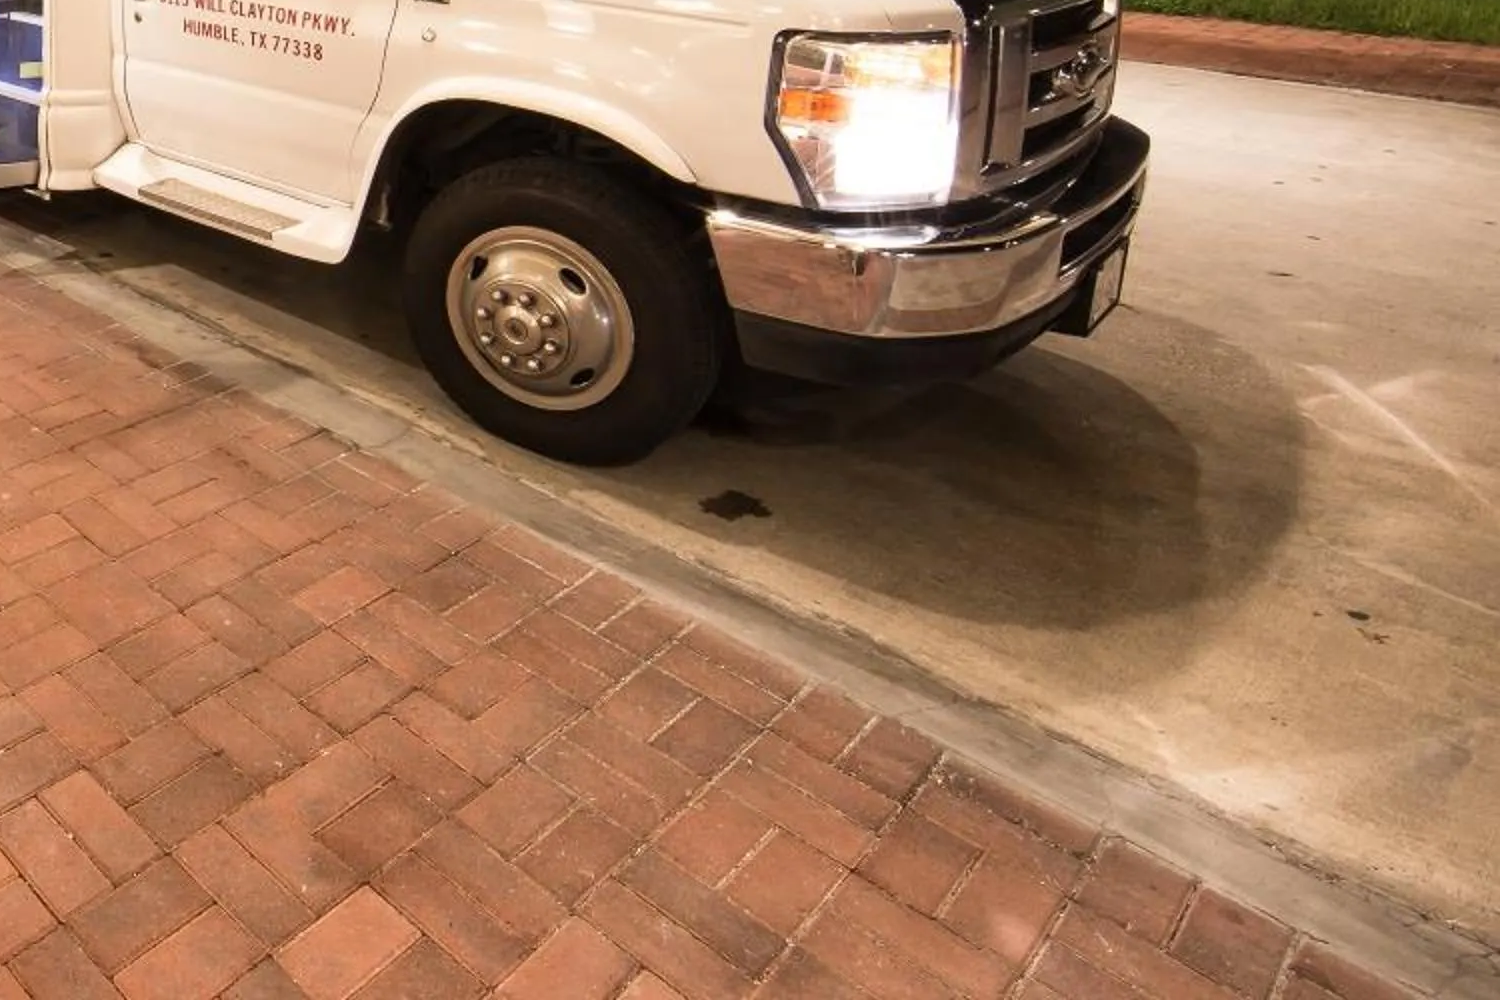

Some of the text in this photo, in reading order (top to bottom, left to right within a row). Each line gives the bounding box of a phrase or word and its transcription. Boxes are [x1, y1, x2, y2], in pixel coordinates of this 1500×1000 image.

[230, 0, 298, 28] CLAYTON
[301, 11, 356, 37] PKWY.
[250, 31, 268, 49] TX
[272, 35, 323, 61] 77338
